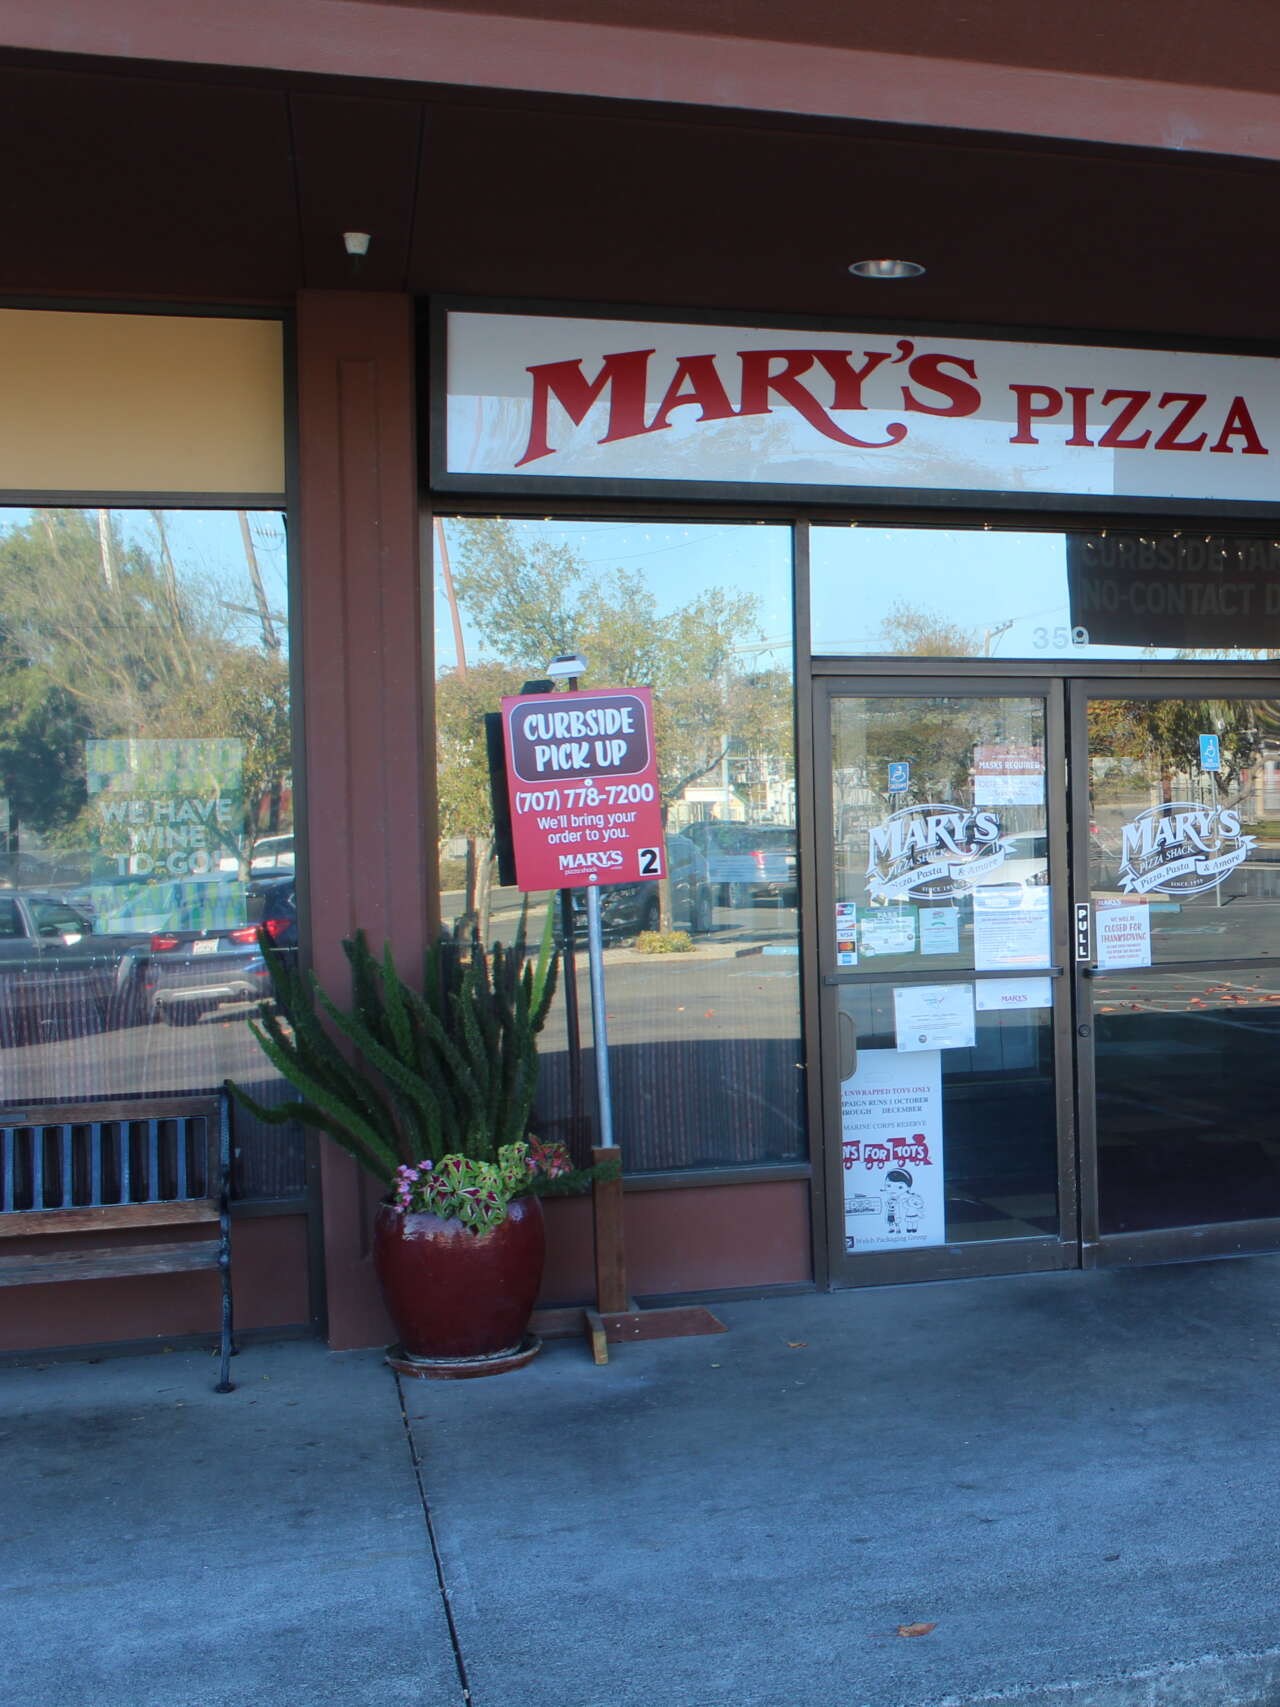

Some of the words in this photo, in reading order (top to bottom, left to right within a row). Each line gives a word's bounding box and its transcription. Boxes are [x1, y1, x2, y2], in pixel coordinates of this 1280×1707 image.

[514, 339, 982, 468] MARY'S
[1009, 383, 1269, 455] PIZZA
[1082, 579, 1256, 616] NO-CONTACT
[1032, 626, 1089, 650] 359
[522, 707, 635, 742] CURBSIDE
[534, 743, 590, 772] PICK
[595, 740, 627, 767] UP
[979, 761, 1003, 769] MASKS
[1005, 761, 1041, 770] REQUIRED
[99, 800, 145, 823] WE
[155, 799, 232, 822] HAVE
[515, 791, 561, 815] (707)
[564, 783, 655, 809] 778-7200
[537, 815, 567, 830] We'll
[571, 813, 604, 829] bring
[608, 811, 637, 827] your
[128, 825, 206, 849] WINE
[548, 830, 581, 844] order
[585, 830, 598, 842] to
[602, 828, 630, 843] you.
[865, 807, 1000, 879] MARY'S
[1119, 804, 1241, 873] MARY'S
[641, 849, 659, 874] 2
[1140, 852, 1163, 873] PIZZA
[1165, 844, 1197, 860] SHACK
[1166, 862, 1189, 876] Pasta
[1203, 863, 1210, 872] &
[1212, 854, 1240, 869] Amore
[917, 868, 943, 880] Pasta
[1078, 909, 1087, 956] PULL
[1104, 924, 1128, 933] CLOSED
[1130, 923, 1142, 932] FOR
[844, 1088, 891, 1097] UNWRAPPED
[882, 1106, 923, 1114] DECEMBER
[865, 1146, 888, 1160] FOR
[894, 1145, 925, 1159] TOTS
